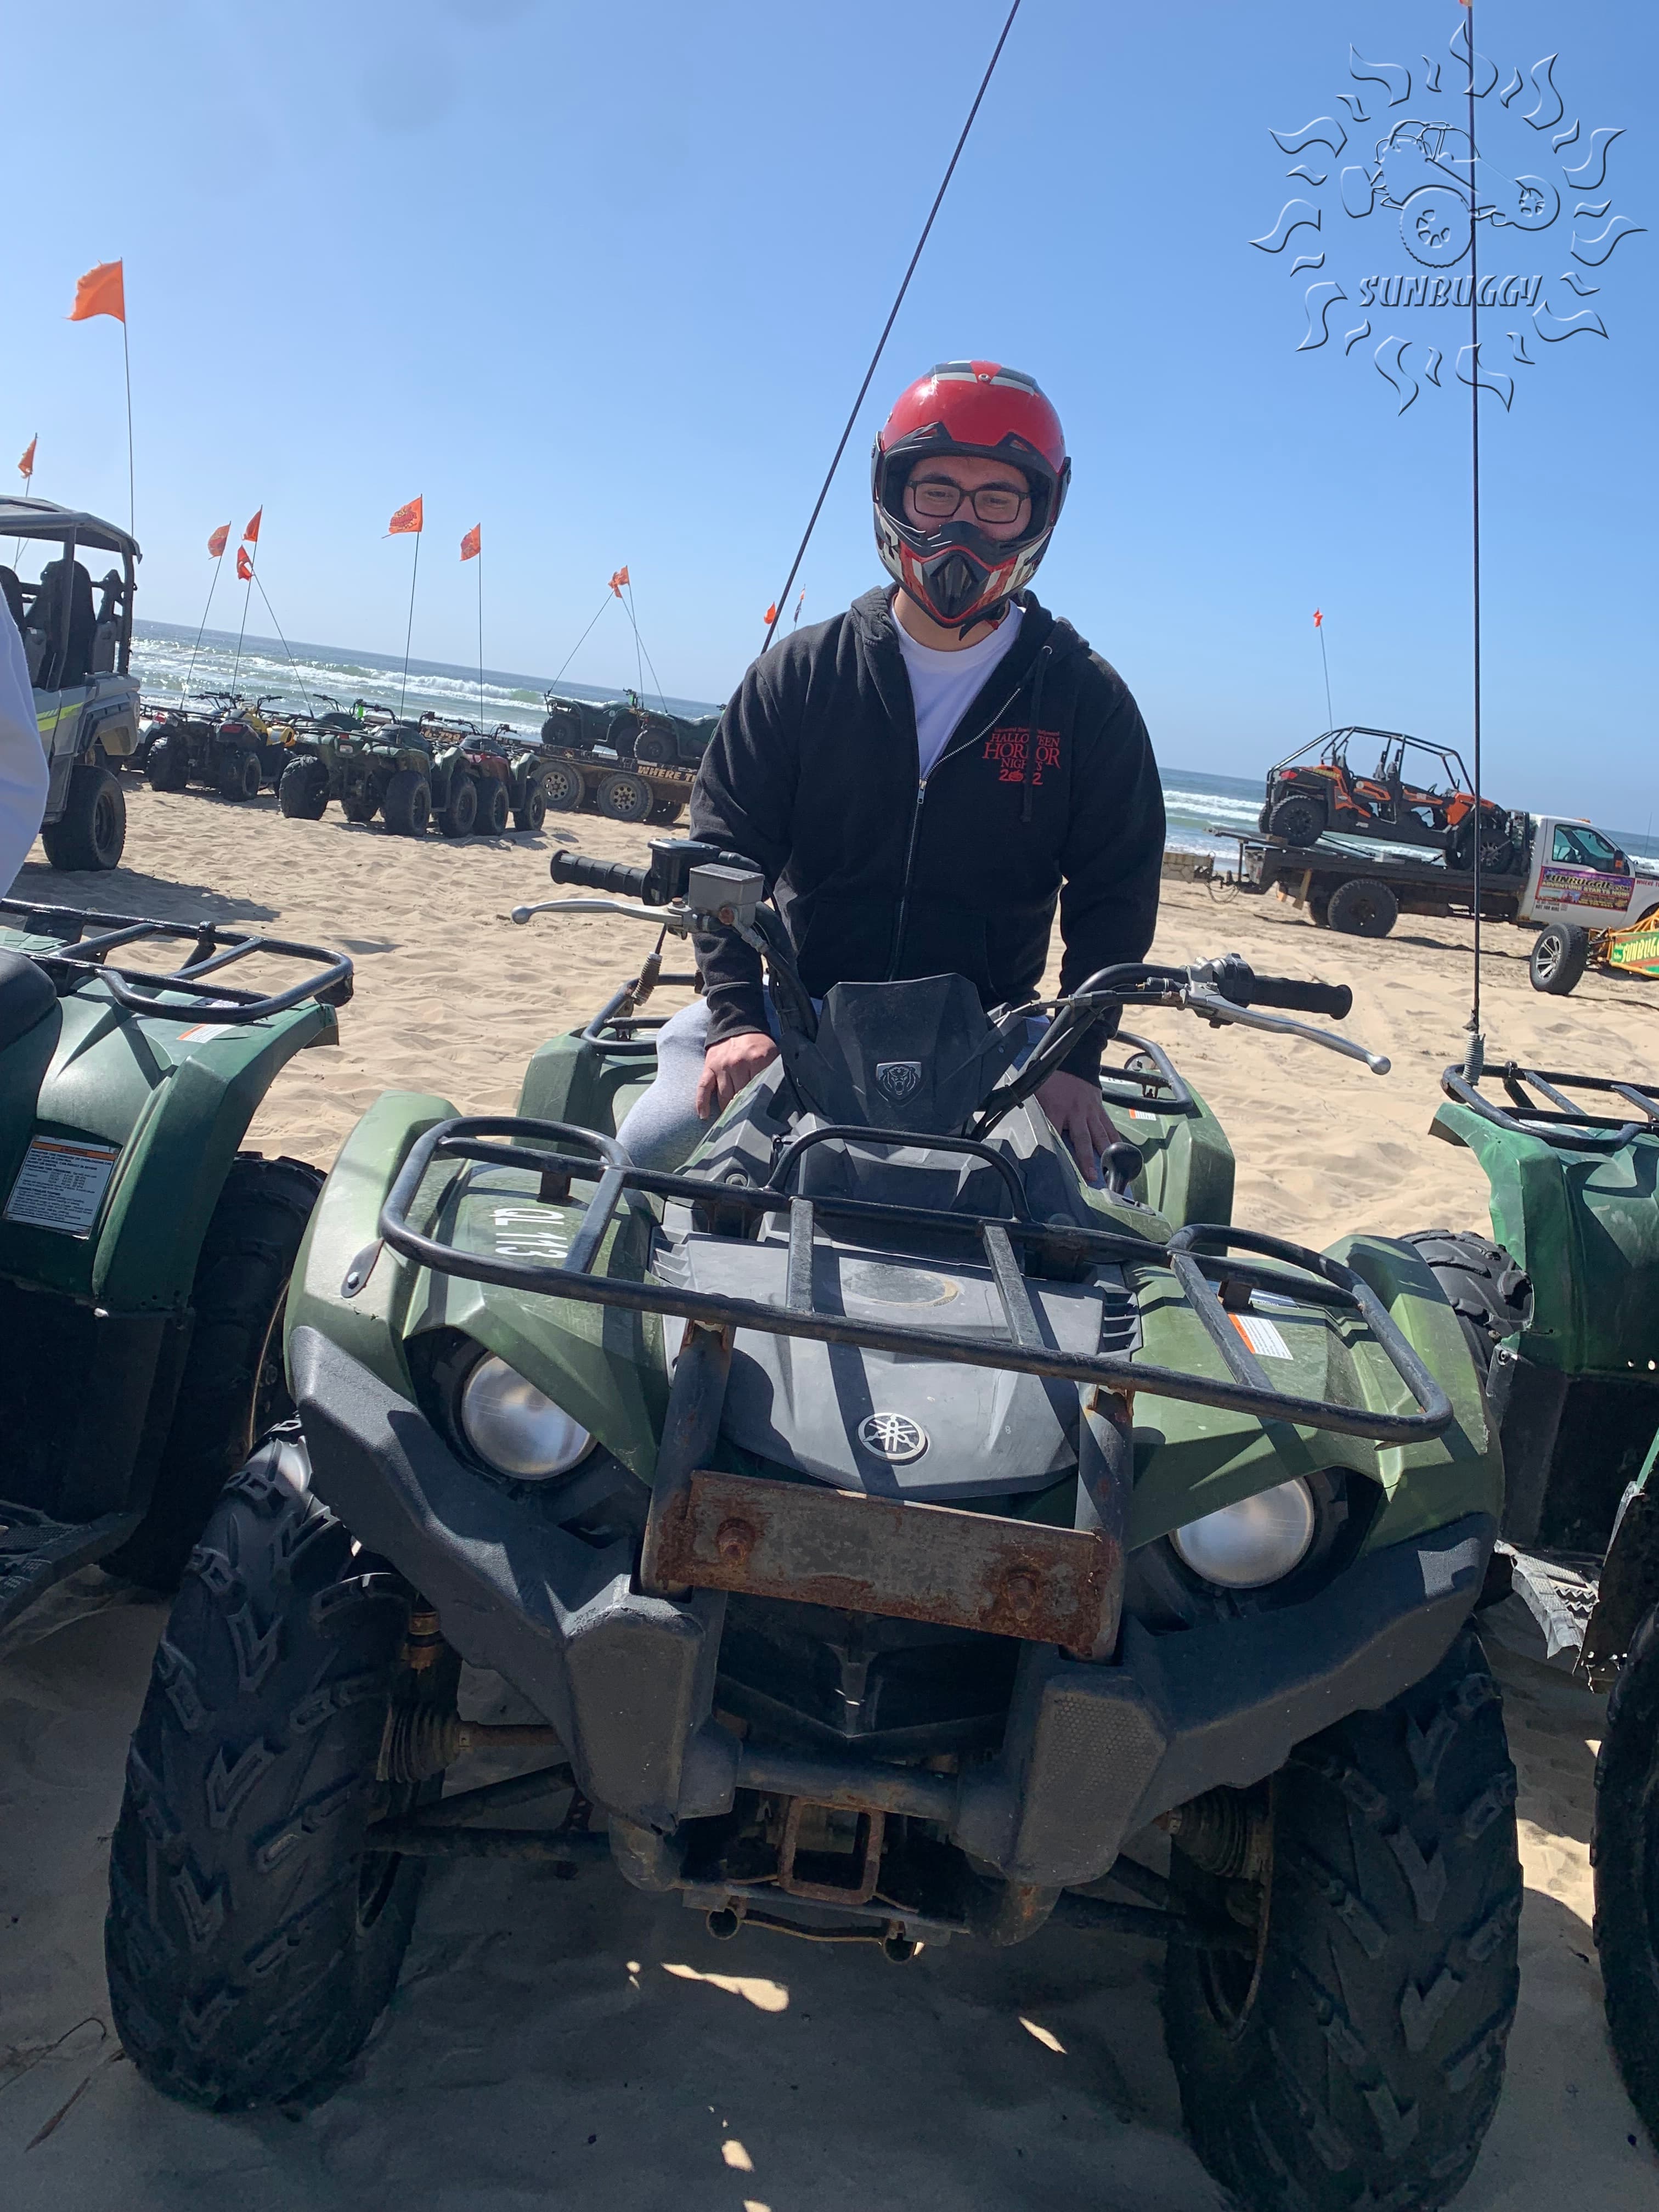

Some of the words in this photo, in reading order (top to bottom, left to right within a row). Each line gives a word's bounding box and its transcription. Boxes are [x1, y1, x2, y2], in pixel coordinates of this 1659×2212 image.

[990, 733, 1060, 747] HALLOEEN
[982, 742, 1061, 769] HOROR
[637, 766, 682, 781] WHERE
[1542, 881, 1582, 891] ADVENTURE
[1583, 886, 1610, 895] STARTS
